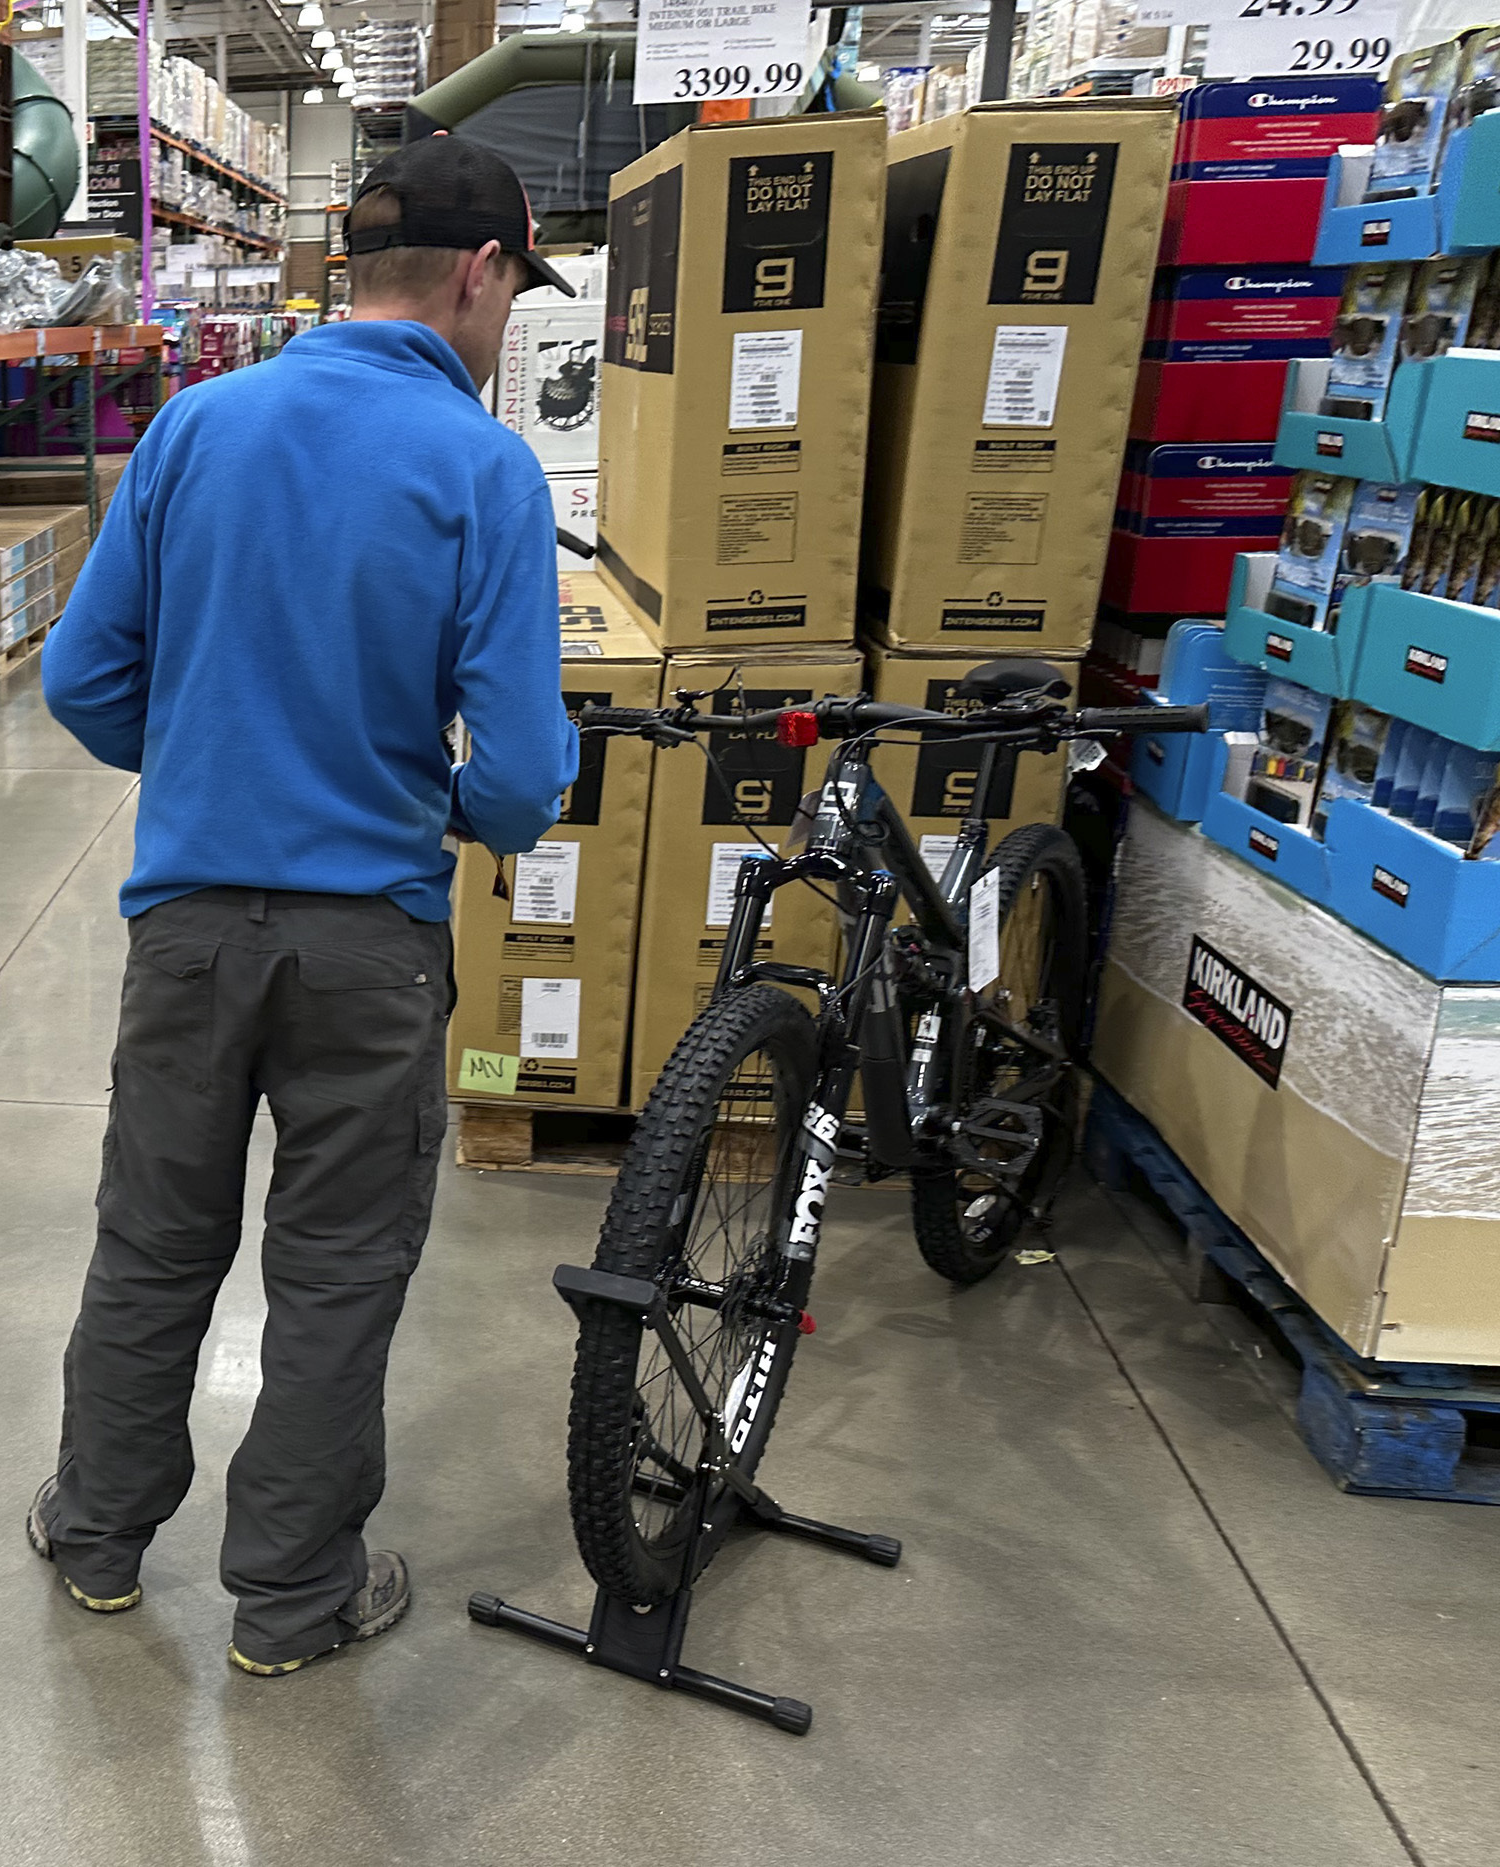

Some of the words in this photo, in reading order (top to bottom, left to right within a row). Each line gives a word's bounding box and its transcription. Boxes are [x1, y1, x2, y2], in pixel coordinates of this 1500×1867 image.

[650, 8, 696, 20] INTENSE
[716, 5, 749, 17] TRAIL
[750, 3, 777, 14] BIKE
[647, 19, 694, 31] MEDIUM
[695, 18, 712, 29] OR
[713, 16, 752, 28] LARGE
[1289, 36, 1391, 71] 29.99
[673, 62, 802, 98] 3399.99
[1248, 93, 1339, 110] Champion
[1028, 165, 1053, 175] THIS
[1054, 165, 1078, 175] END
[1079, 164, 1098, 175] UP
[748, 177, 772, 186] THIS
[774, 176, 796, 185] END
[798, 175, 814, 184] UP
[1025, 175, 1052, 189] DO
[1055, 175, 1095, 189] NOT
[747, 187, 773, 201] DO
[776, 183, 813, 199] NOT
[1024, 190, 1054, 202] LAY
[1054, 190, 1092, 202] FLAT
[747, 201, 773, 214] LAY
[776, 199, 811, 212] FLAT
[1225, 276, 1313, 293] Champion
[505, 324, 520, 432] ONDORS
[1197, 455, 1274, 473] Champio
[1192, 946, 1288, 1050] KIRKLAND
[808, 1101, 840, 1141] 36
[788, 1158, 834, 1246] FOX
